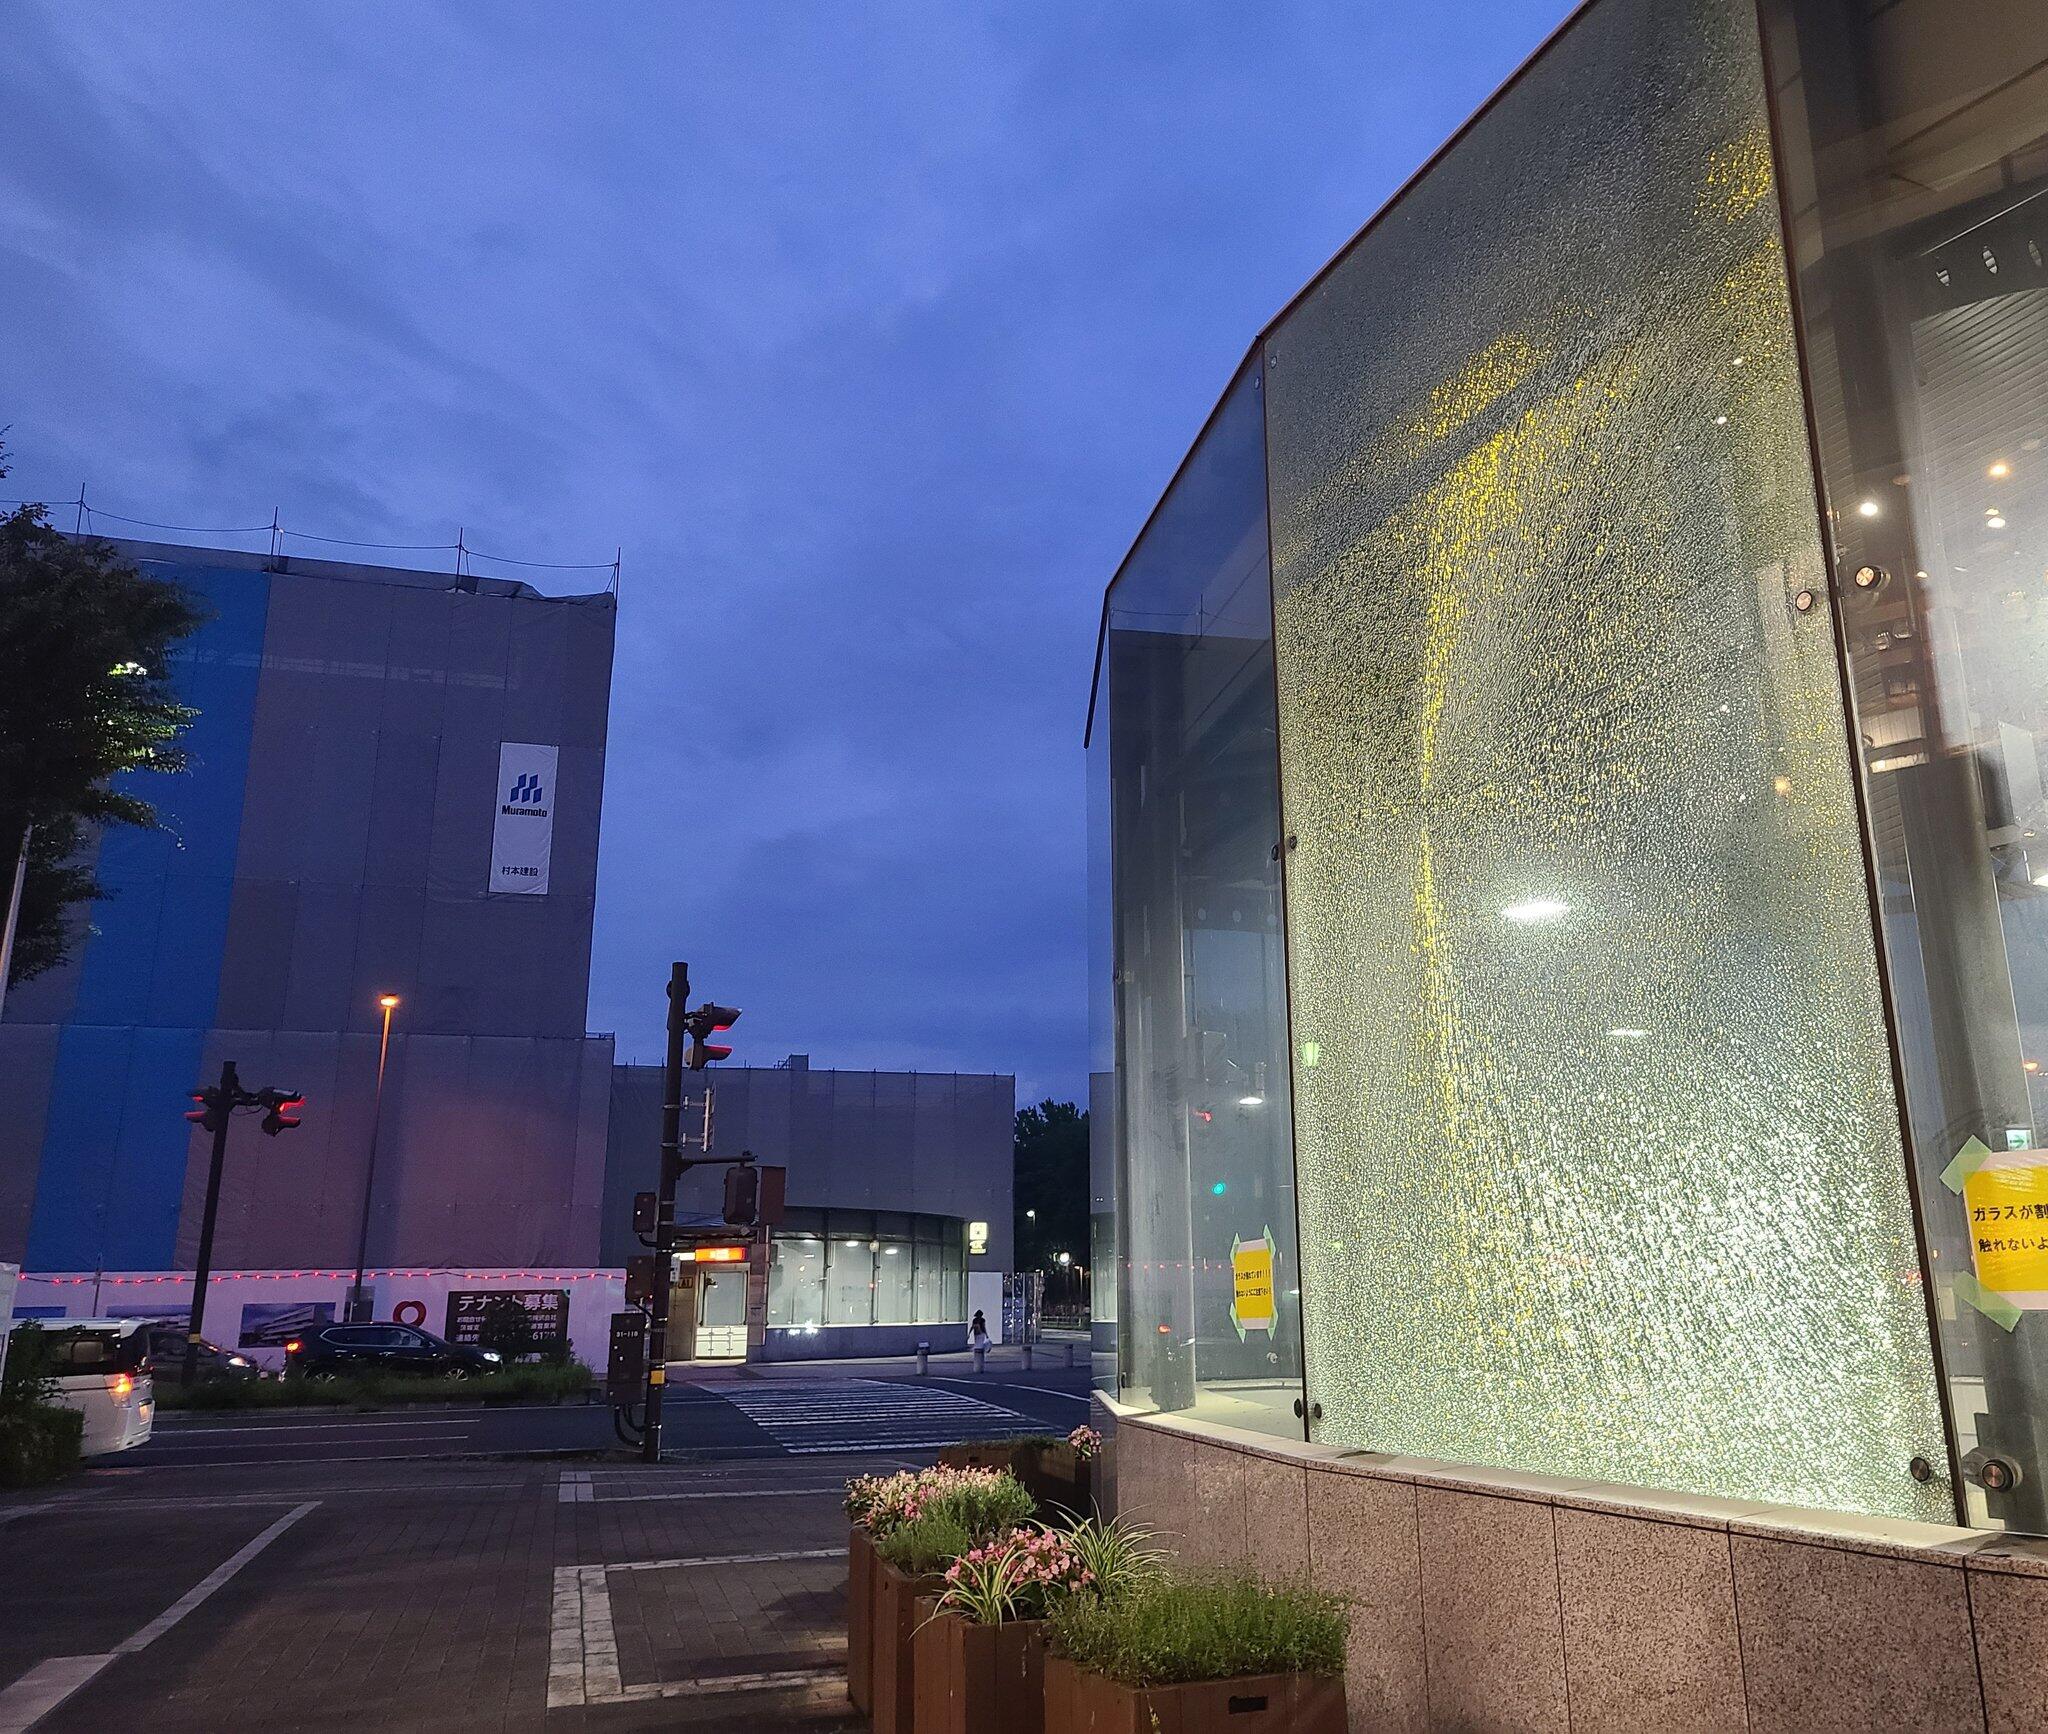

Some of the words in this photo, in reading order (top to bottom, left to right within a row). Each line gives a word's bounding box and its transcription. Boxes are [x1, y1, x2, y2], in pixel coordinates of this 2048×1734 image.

[501, 804, 547, 818] Muramoto
[501, 865, 538, 877] 村本建設
[1973, 1203, 2048, 1222] ガラスが割
[1978, 1236, 2048, 1253] 触れないよ
[458, 1293, 559, 1312] テナント募集
